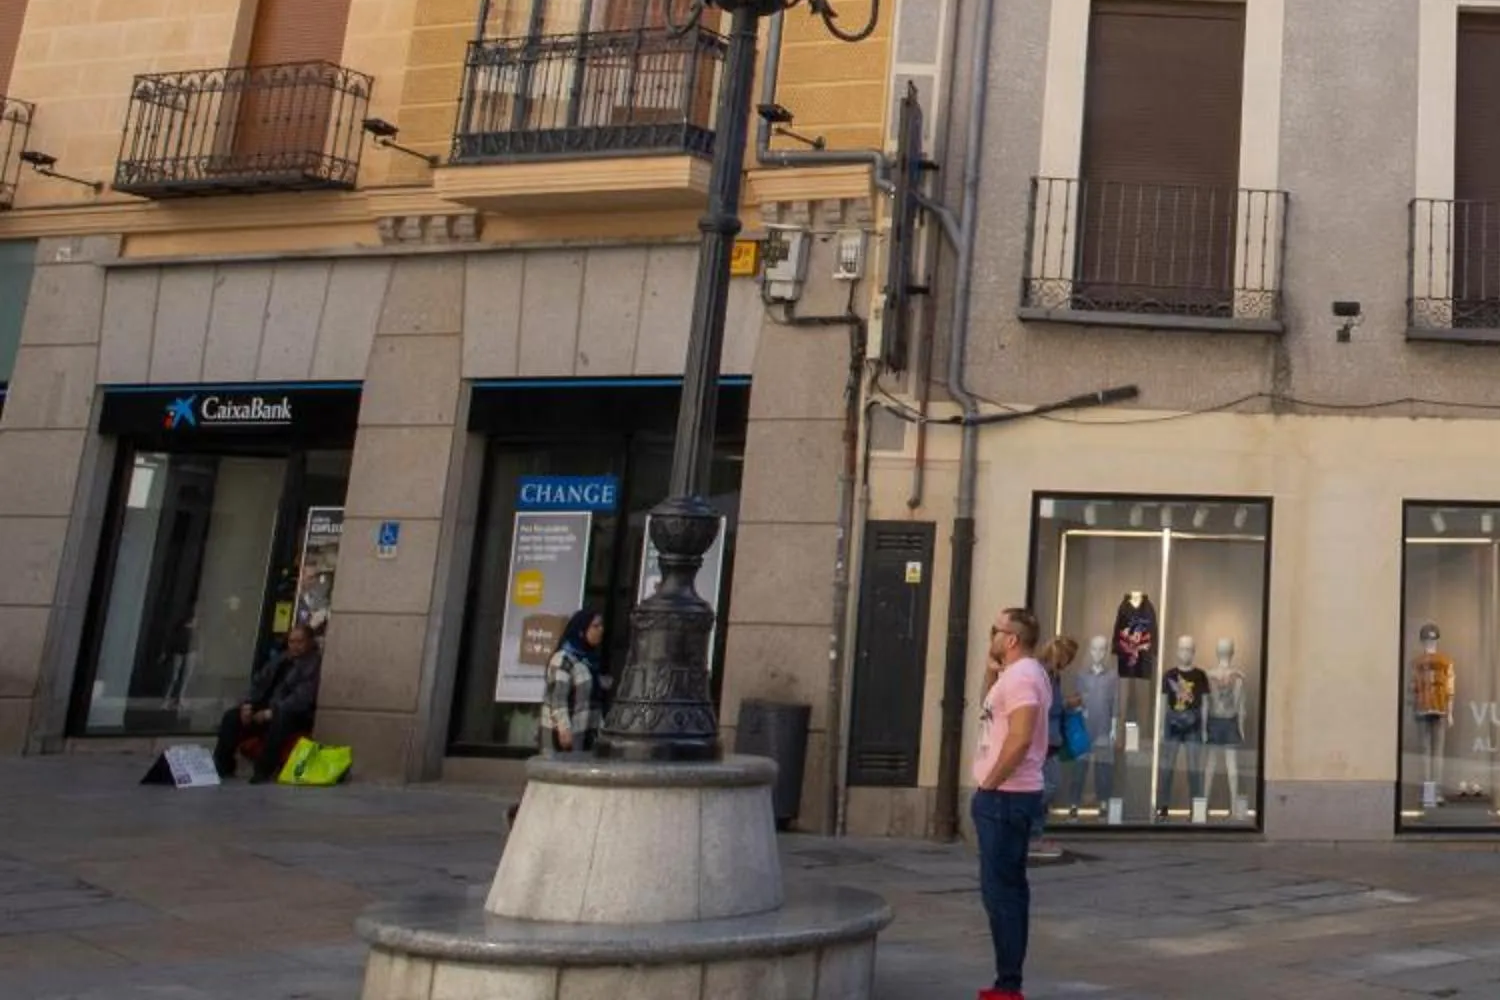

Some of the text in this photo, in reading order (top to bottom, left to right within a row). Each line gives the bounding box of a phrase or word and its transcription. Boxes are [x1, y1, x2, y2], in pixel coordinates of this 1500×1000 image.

[201, 396, 292, 420] CaixaBank
[520, 483, 614, 505] CHANGE
[1472, 735, 1498, 753] AL
